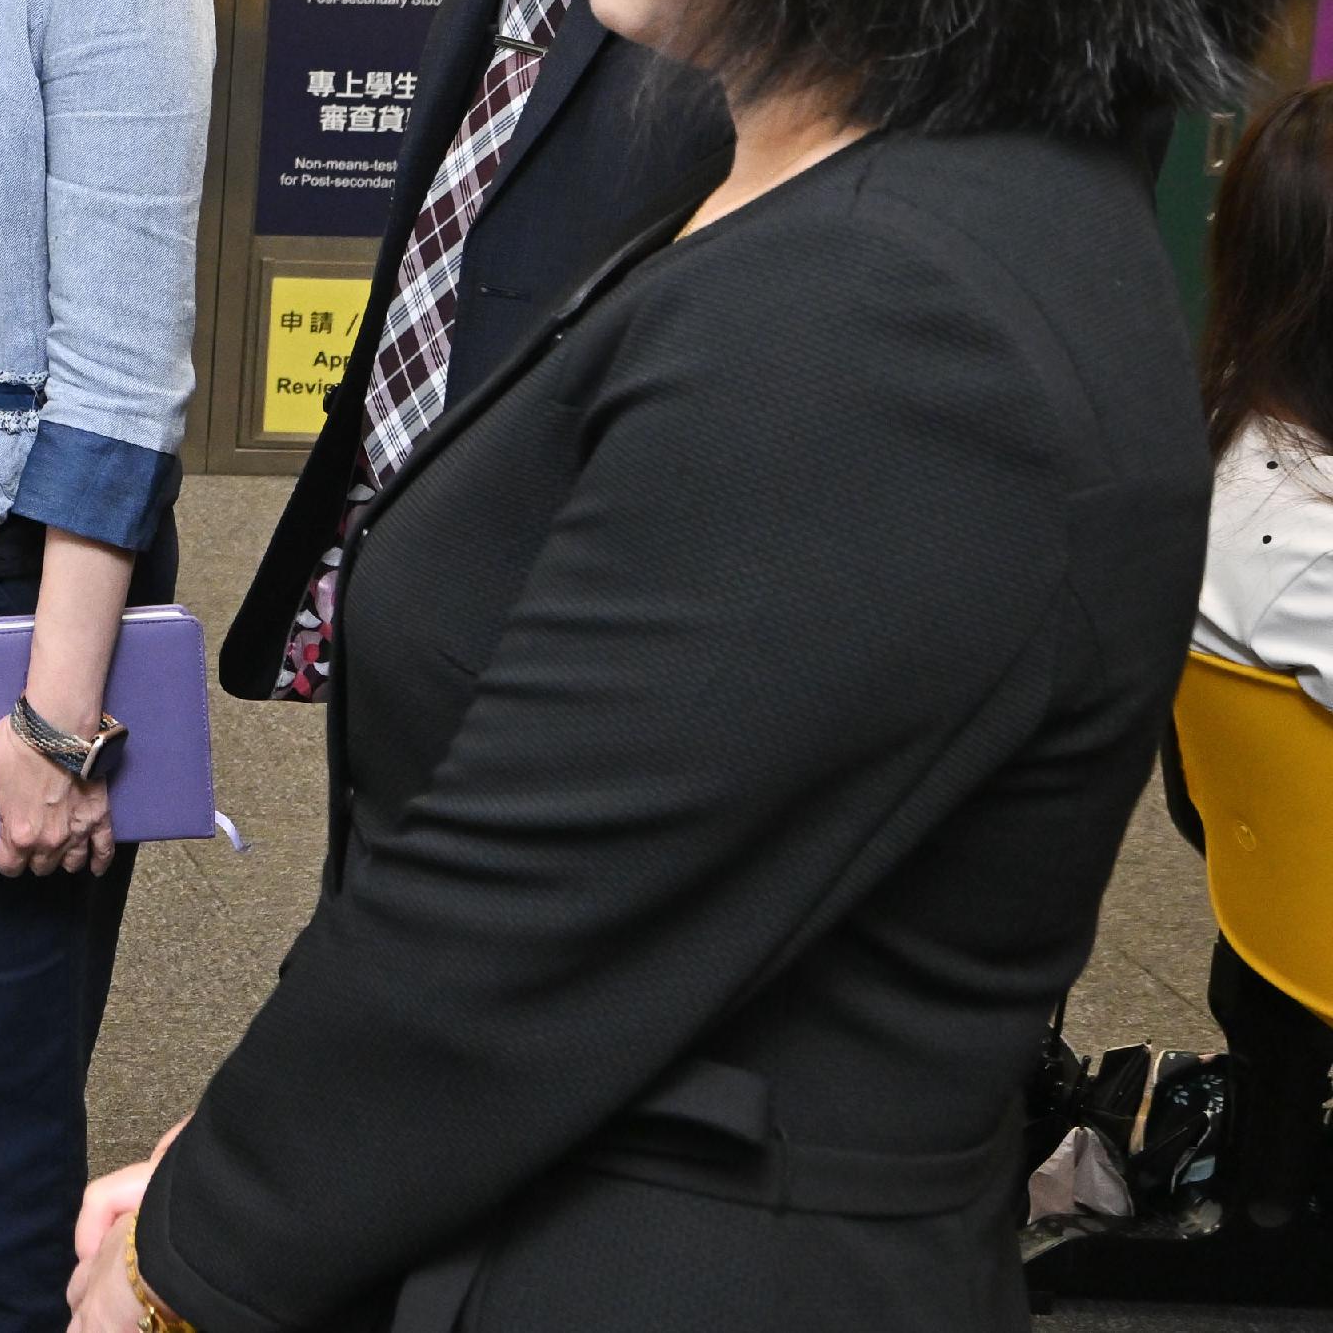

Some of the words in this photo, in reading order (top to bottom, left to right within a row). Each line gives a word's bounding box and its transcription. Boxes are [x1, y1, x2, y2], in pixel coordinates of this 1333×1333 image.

[307, 70, 418, 99] 專上學生
[320, 104, 411, 133] 審查貸
[280, 173, 298, 186] for
[277, 378, 341, 395] Revie
